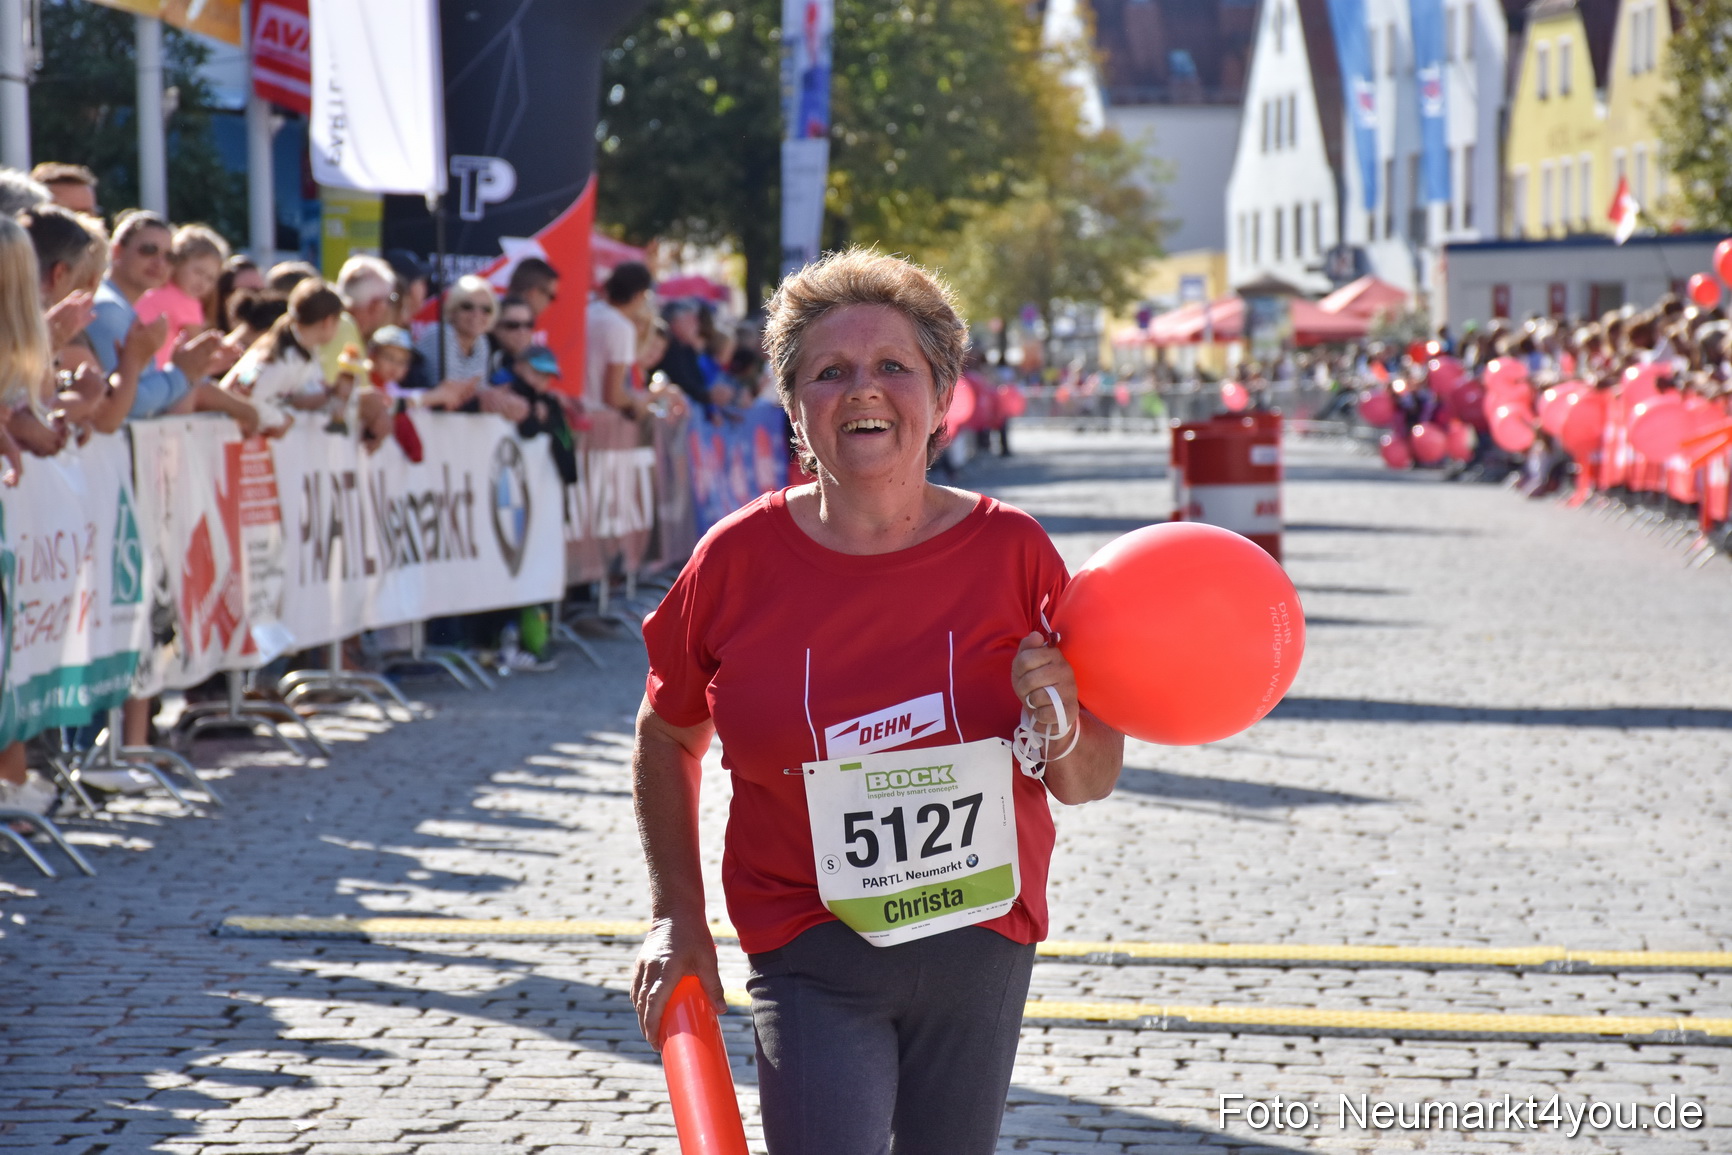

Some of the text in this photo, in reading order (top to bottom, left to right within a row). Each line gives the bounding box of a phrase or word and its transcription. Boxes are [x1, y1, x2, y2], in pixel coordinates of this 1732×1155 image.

[1269, 605, 1282, 669] richtigen
[1278, 601, 1292, 645] DEHN
[1262, 672, 1281, 702] Weg
[859, 712, 912, 746] DEHN
[865, 764, 957, 792] BOCK
[867, 784, 959, 799] inspired by smart concepts
[844, 792, 983, 868] 5127
[827, 859, 835, 870] S
[862, 860, 963, 889] PARTL Neumarkt
[883, 887, 964, 924] Christa
